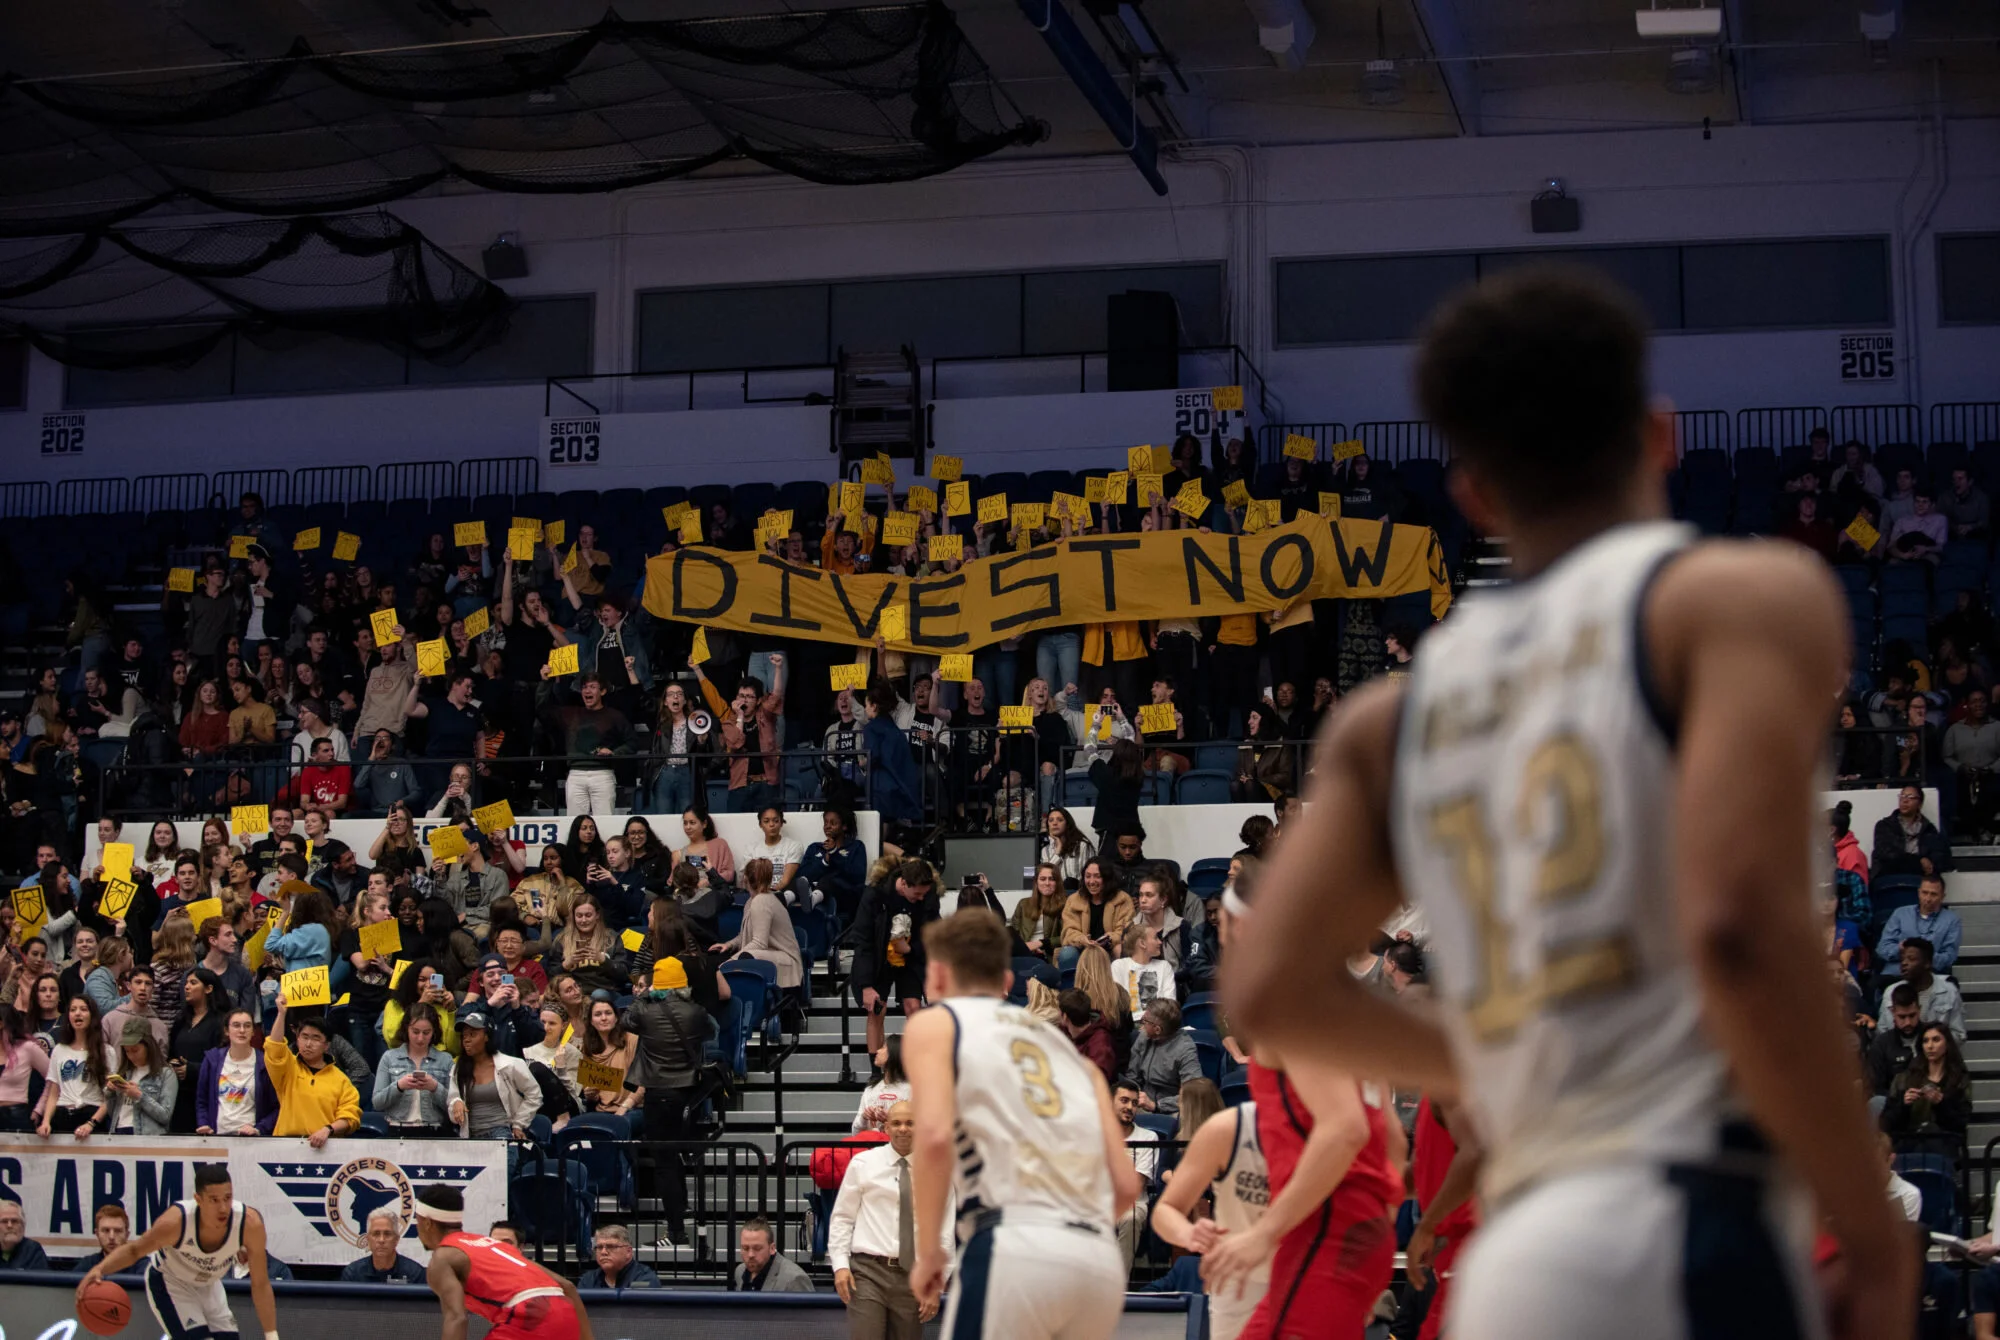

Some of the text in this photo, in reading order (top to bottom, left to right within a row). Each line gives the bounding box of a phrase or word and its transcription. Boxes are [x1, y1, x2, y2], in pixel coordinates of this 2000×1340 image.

[1841, 337, 1893, 350] SECTION
[1841, 352, 1894, 378] 205
[1176, 394, 1211, 407] SECTI
[43, 415, 85, 428] SECTION
[551, 421, 600, 435] SECTION
[1176, 409, 1229, 436] 204
[41, 428, 84, 453] 202
[550, 436, 599, 463] 203
[934, 455, 962, 466] DIVEST
[939, 467, 957, 477] NOW
[1012, 504, 1041, 514] DIVEST
[1017, 515, 1037, 524] NOW
[885, 524, 914, 535] DIVEST
[930, 536, 959, 549] DIVEST
[936, 548, 959, 559] NOW
[673, 521, 1389, 646] DIVEST NOW
[552, 659, 573, 674] NOW
[942, 656, 970, 667] DIVEST
[832, 666, 866, 678] DIVEST
[1001, 707, 1032, 718] DIVEST
[1147, 715, 1170, 731] NOW
[232, 806, 267, 820] DIVEST
[475, 803, 506, 820] DIVEST
[242, 819, 264, 833] NOW
[285, 970, 327, 987] DIVEST
[291, 984, 322, 1001] NOW
[580, 1060, 623, 1077] DIVEST
[1010, 1038, 1064, 1119] 3
[50, 1159, 228, 1236] ARM
[329, 1159, 387, 1222] GEORGE'S
[391, 1175, 414, 1228] ARMY
[491, 1247, 527, 1267] 1
